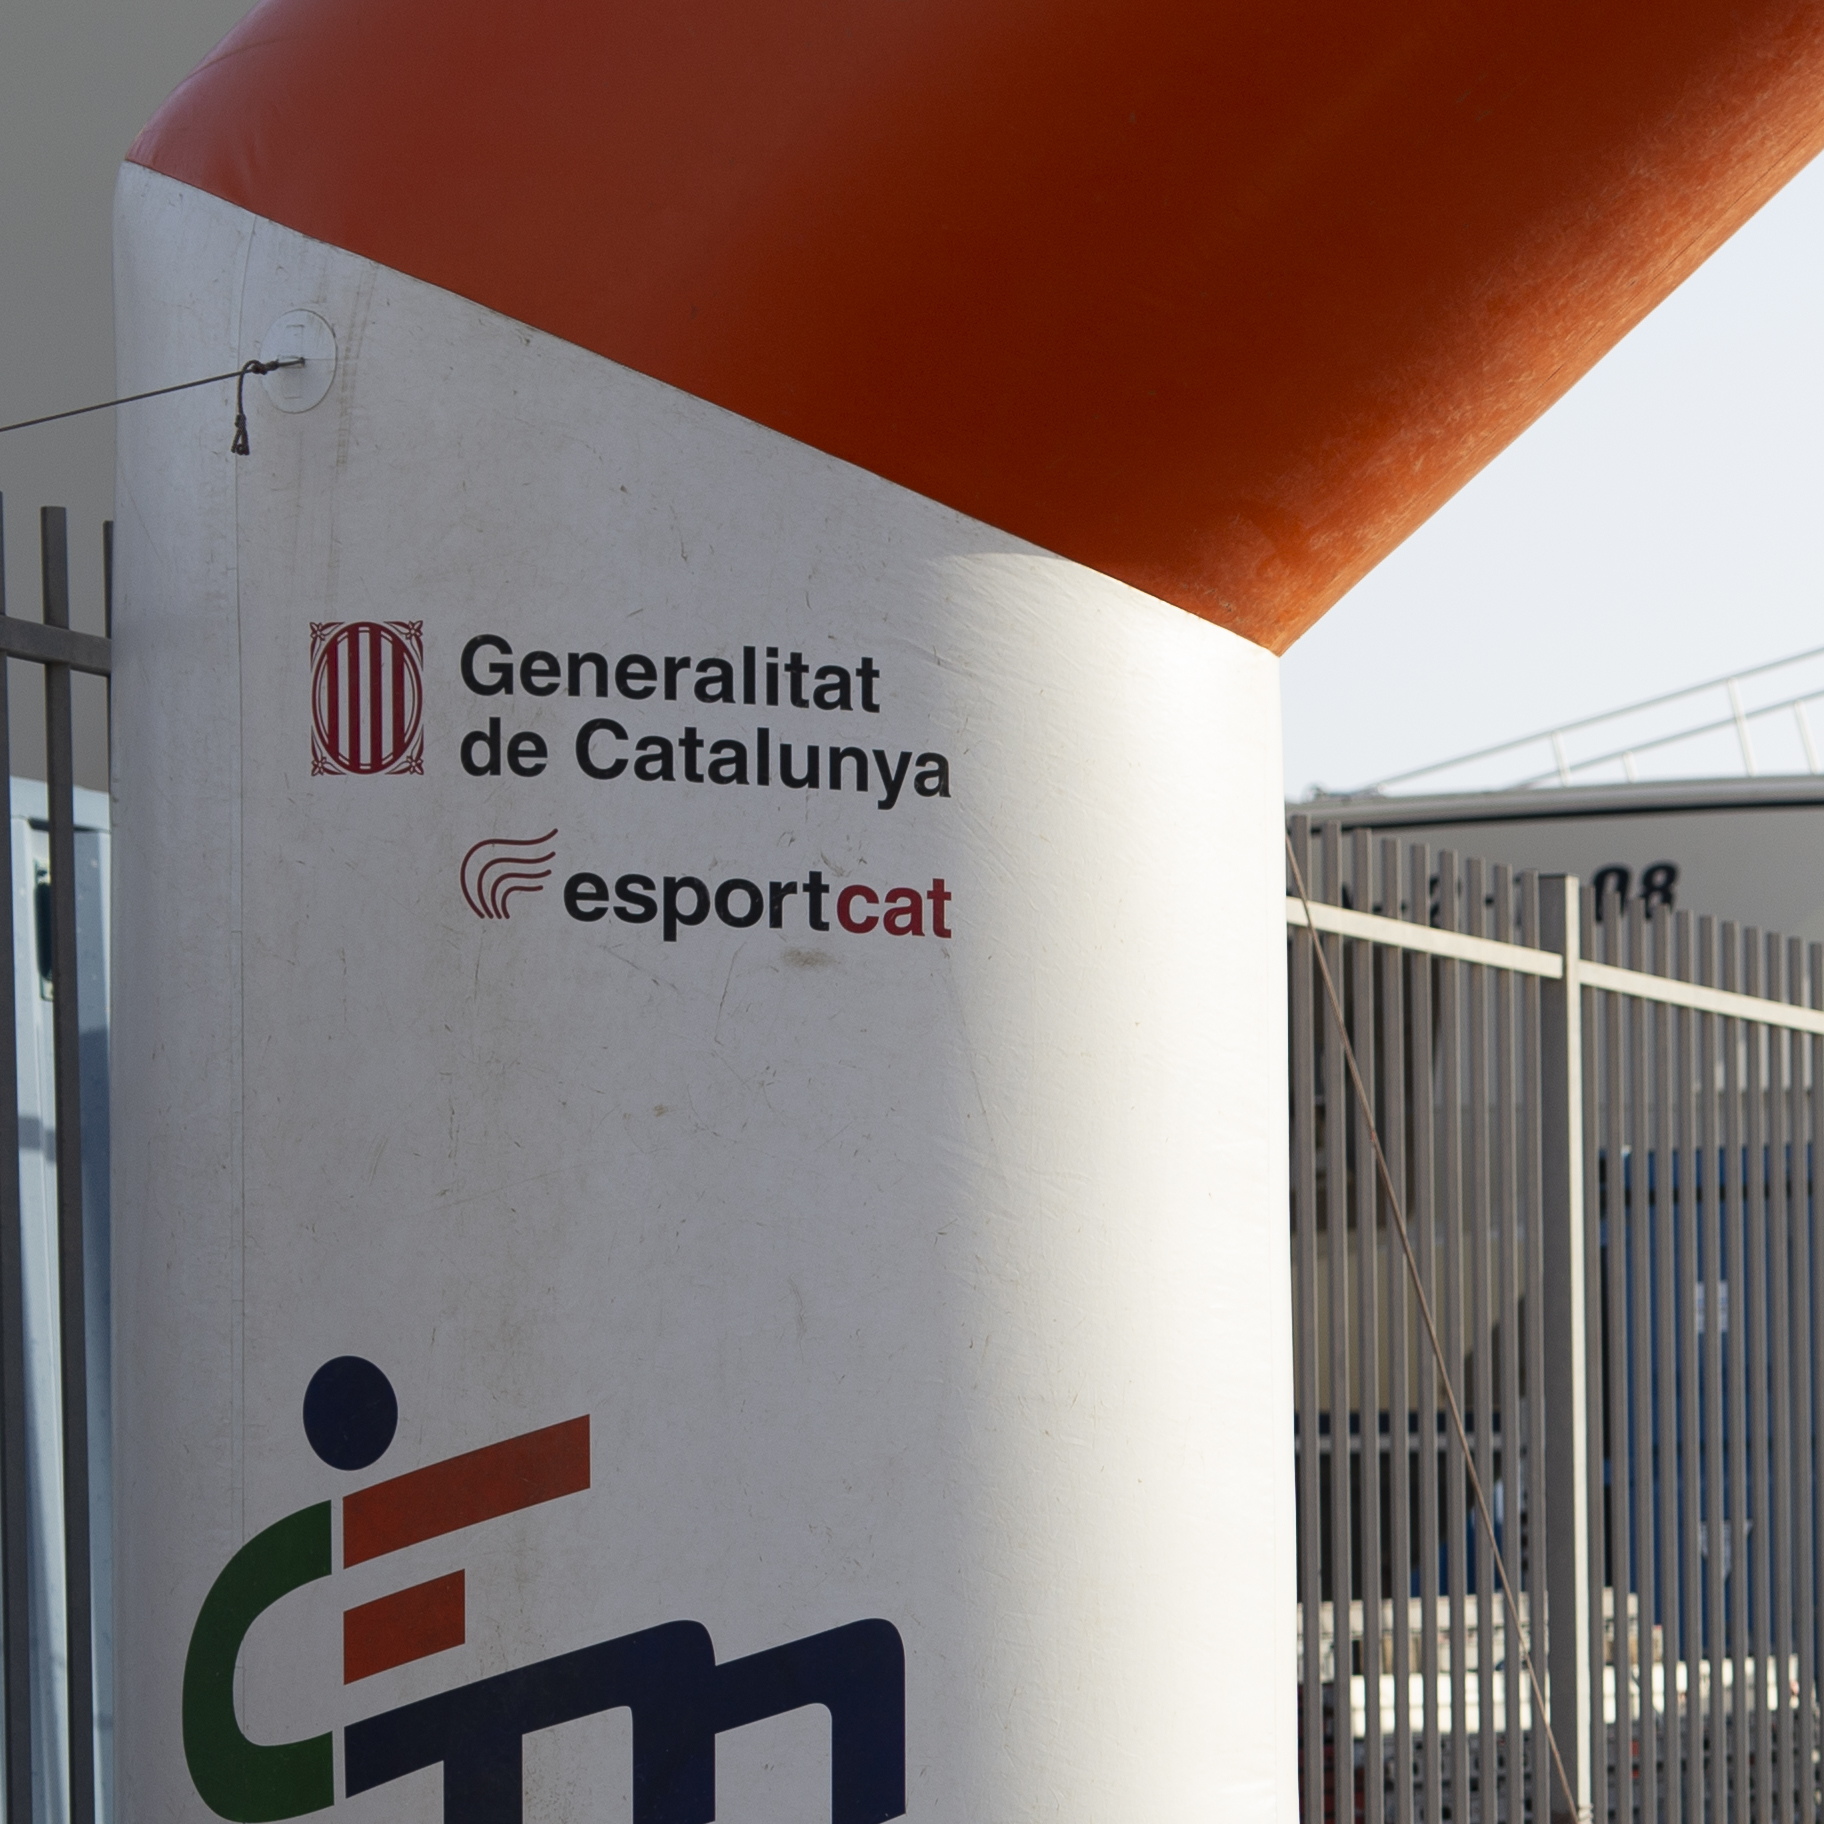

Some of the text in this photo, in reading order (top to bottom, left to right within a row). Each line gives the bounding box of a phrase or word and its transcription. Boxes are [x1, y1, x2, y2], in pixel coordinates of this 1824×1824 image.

[460, 634, 880, 713] Generalitat
[460, 717, 952, 810] de Catalunya
[563, 869, 952, 942] esportcat
